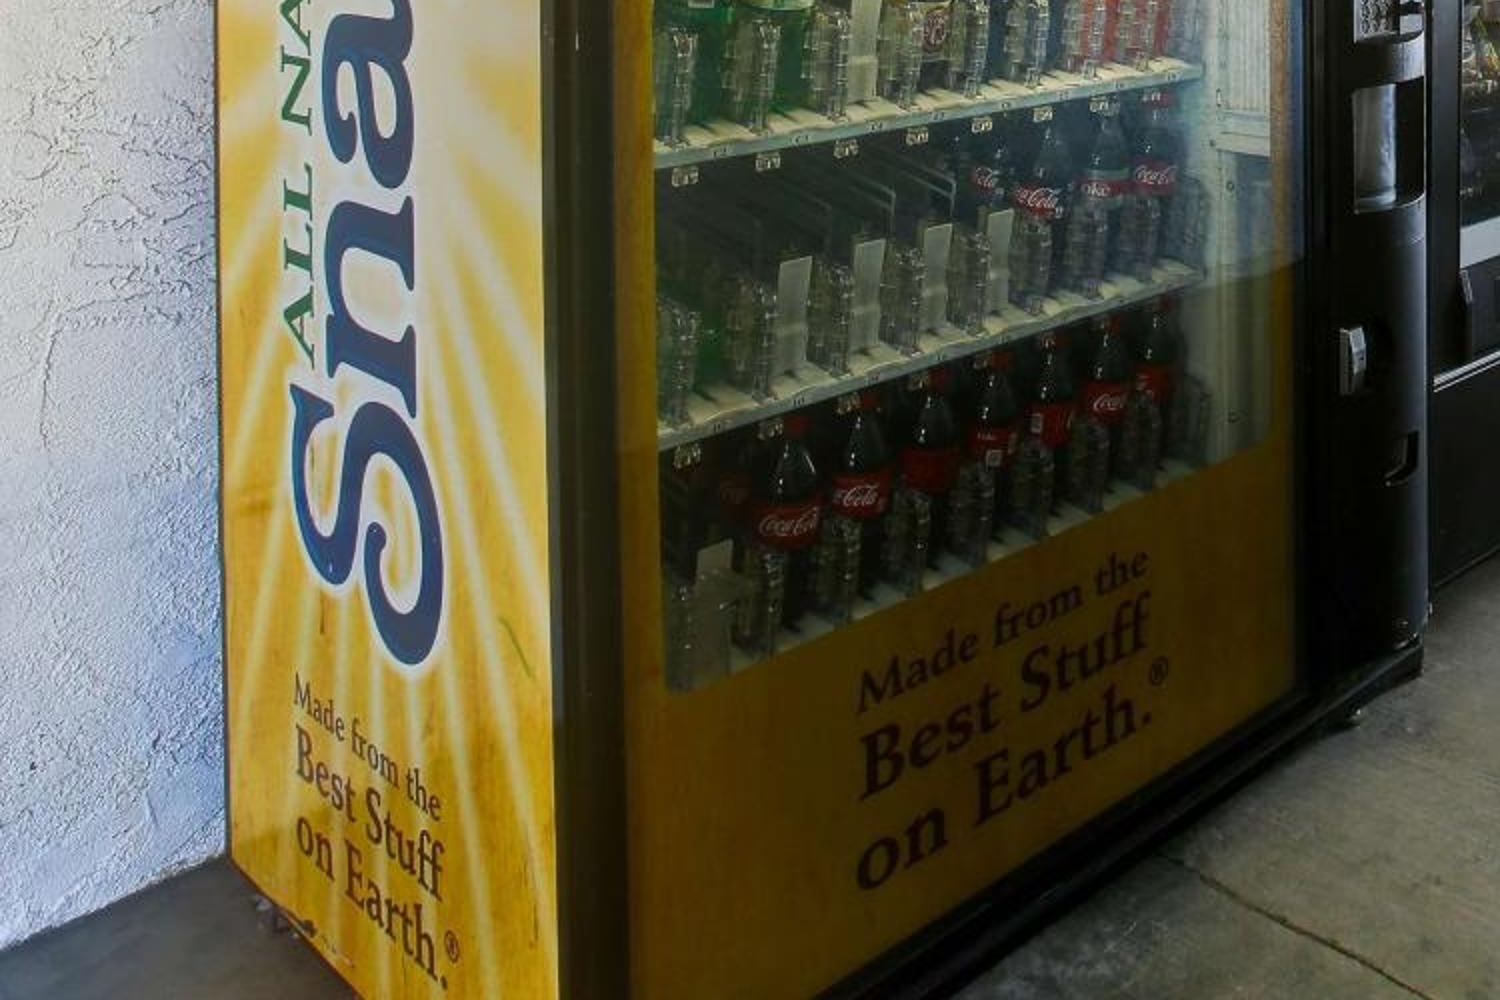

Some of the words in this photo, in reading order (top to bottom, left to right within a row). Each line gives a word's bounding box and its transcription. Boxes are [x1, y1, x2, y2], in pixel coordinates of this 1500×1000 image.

[283, 163, 316, 369] ALL
[857, 629, 980, 715] Made
[992, 584, 1084, 649] from
[1094, 550, 1149, 597] the
[858, 685, 1003, 802] Best
[1020, 590, 1151, 713] Stuff
[294, 673, 345, 742] Made
[350, 718, 400, 791] from
[406, 767, 442, 822] the
[296, 725, 356, 824] Best
[366, 786, 445, 904] Stuff
[296, 816, 335, 880] on
[857, 806, 948, 893] on
